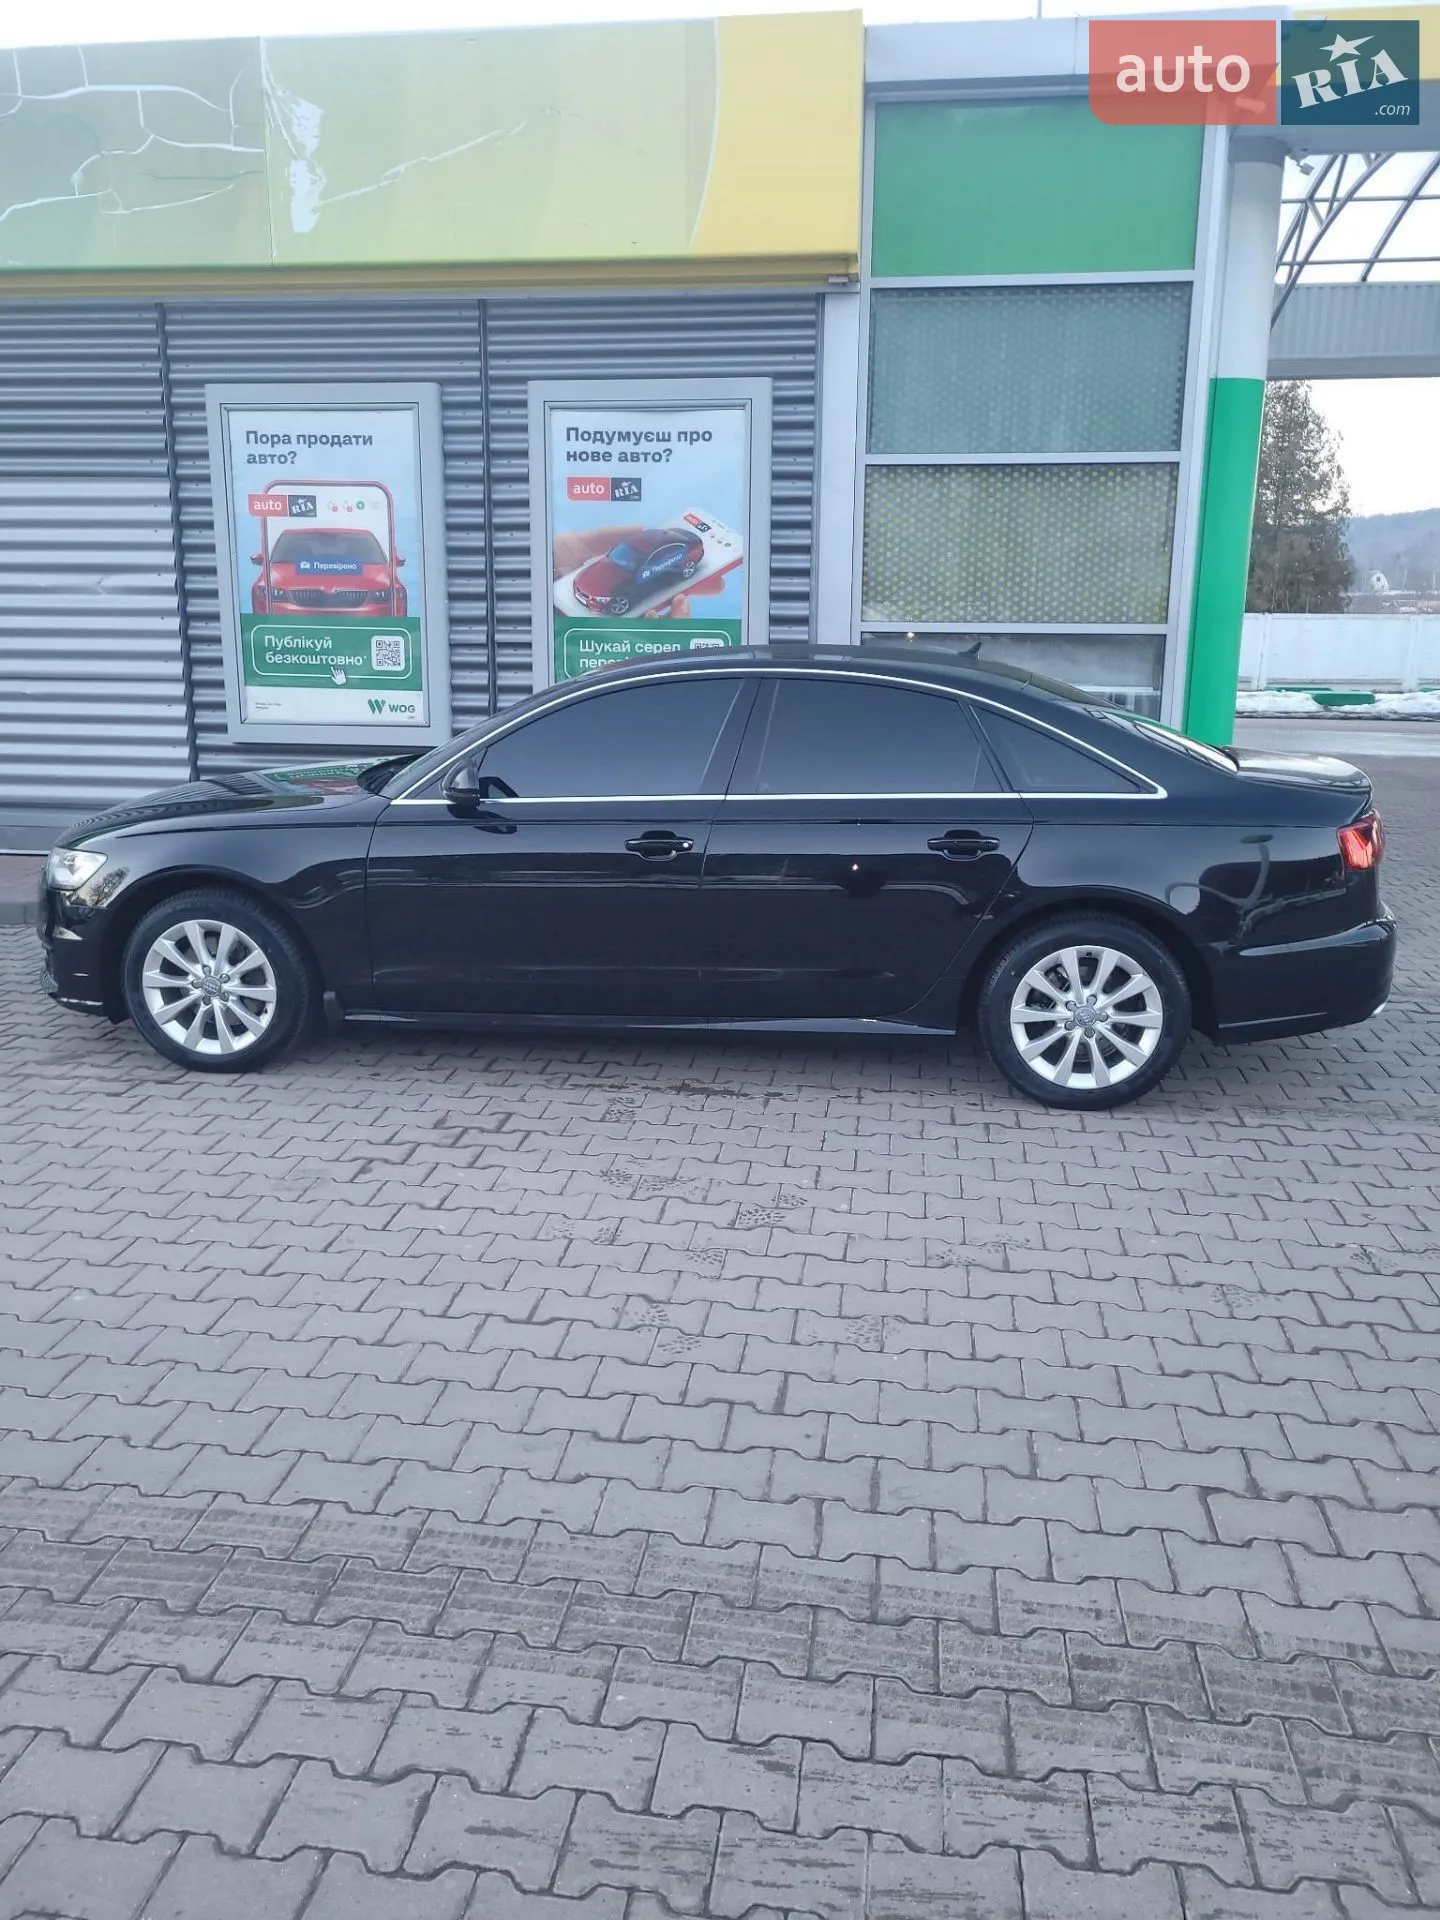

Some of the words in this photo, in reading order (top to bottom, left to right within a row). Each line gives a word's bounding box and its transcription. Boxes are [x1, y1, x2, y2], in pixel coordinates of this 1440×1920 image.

[246, 430, 292, 448] Пора
[296, 433, 373, 448] продати
[566, 427, 671, 445] Подумуєш
[677, 430, 713, 446] про
[246, 451, 297, 465] авто?
[566, 450, 612, 462] нове
[618, 448, 673, 463] авто?
[573, 482, 605, 494] auto
[614, 485, 638, 498] RIA
[253, 499, 282, 511] auto
[291, 501, 314, 514] RIA
[264, 635, 333, 651] Публікуй
[579, 639, 631, 655] Шукай
[389, 703, 416, 713] WOG
